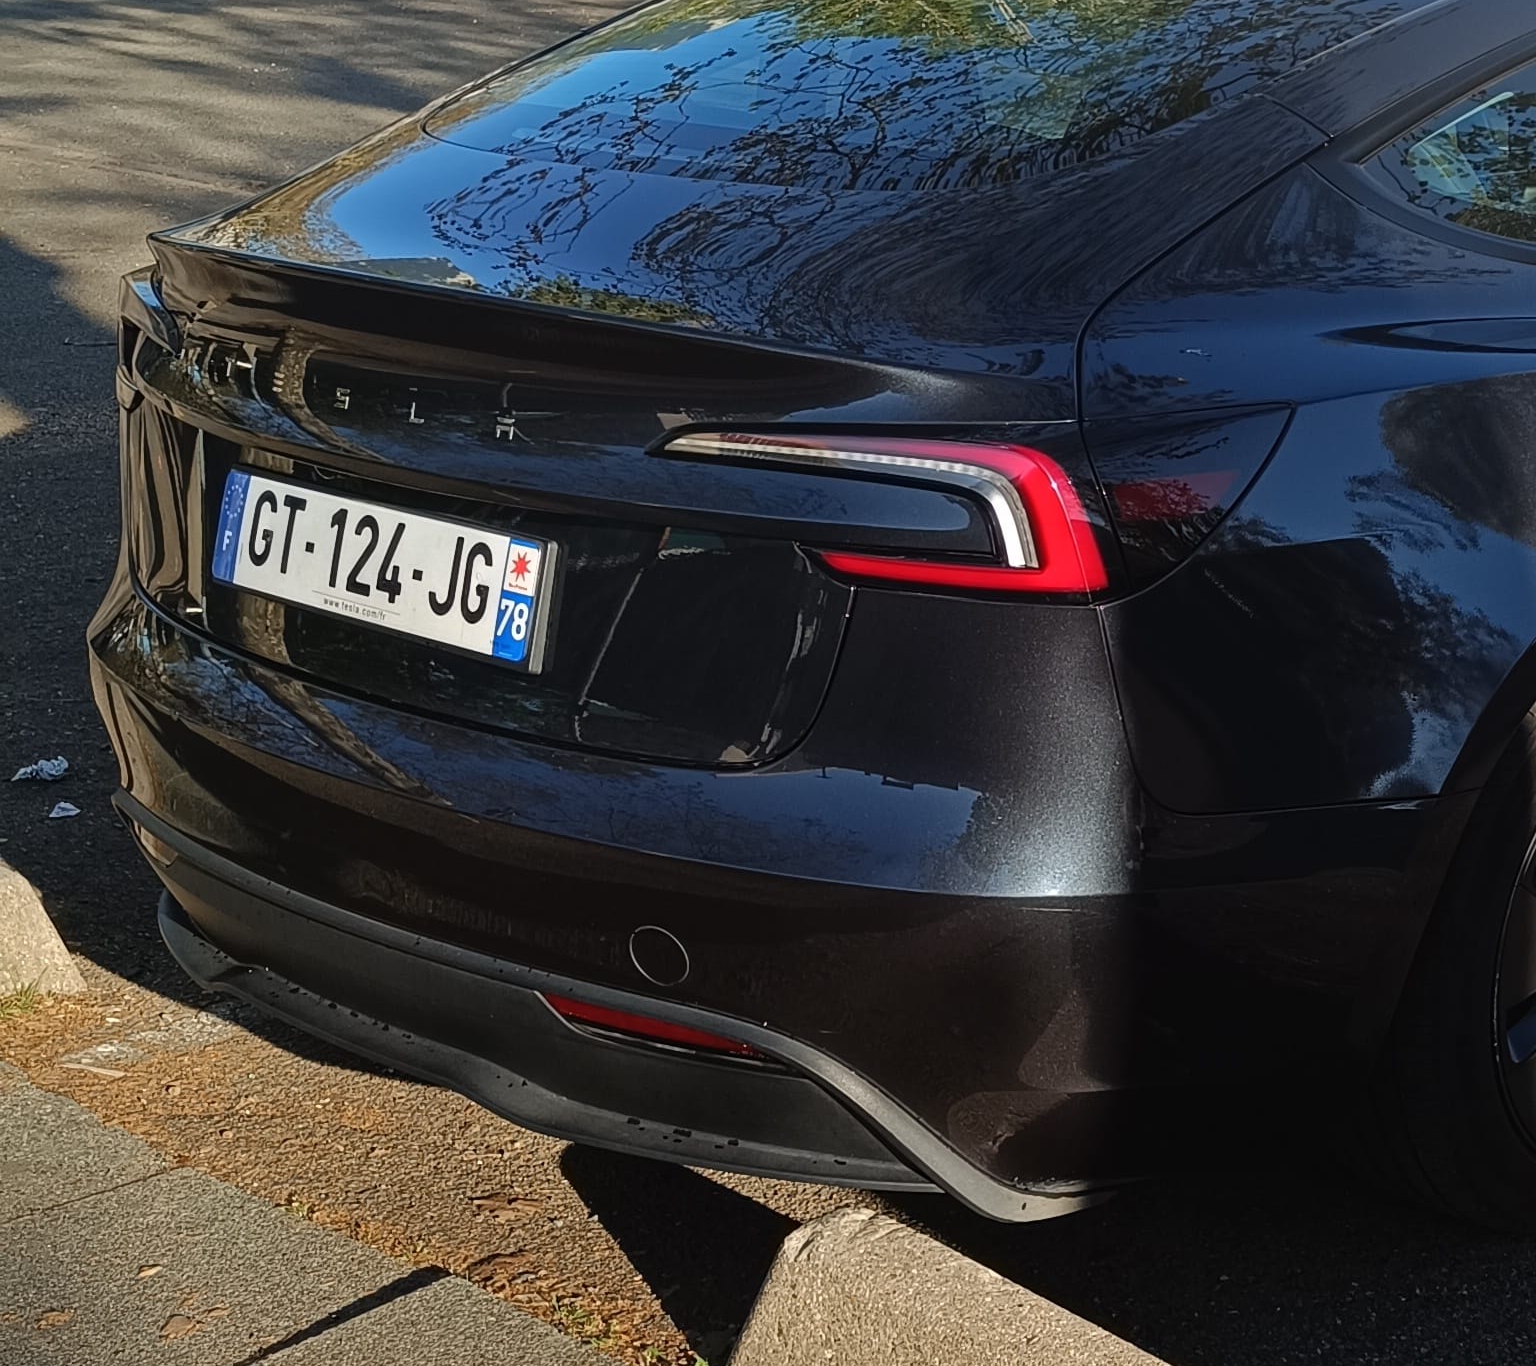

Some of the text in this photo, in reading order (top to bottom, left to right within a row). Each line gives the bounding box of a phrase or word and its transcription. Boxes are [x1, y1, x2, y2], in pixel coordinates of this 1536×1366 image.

[222, 530, 232, 551] F
[248, 490, 493, 624] GT-124-JG
[496, 598, 529, 641] 78
